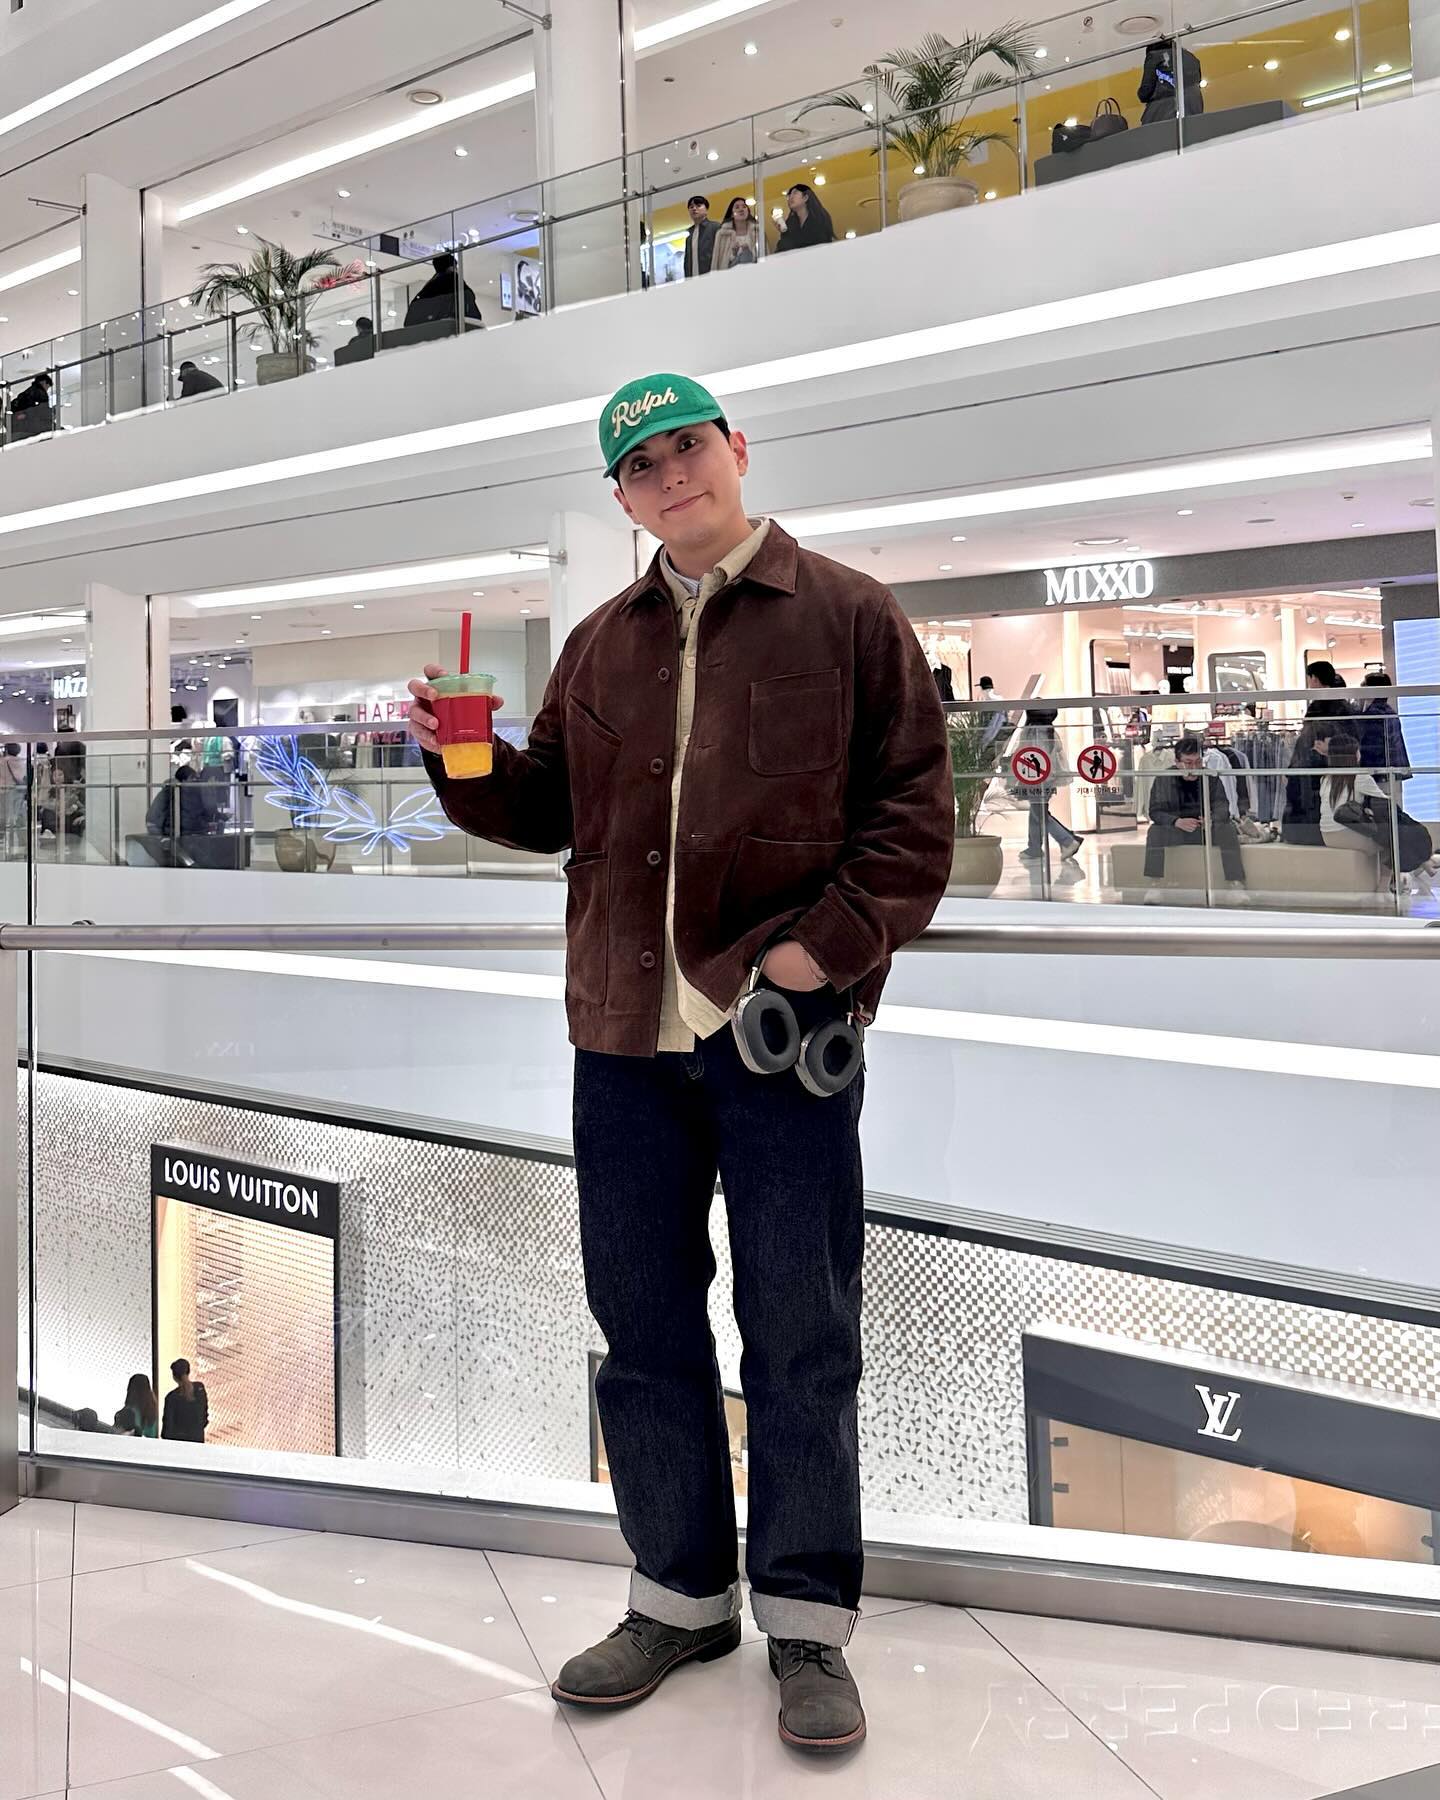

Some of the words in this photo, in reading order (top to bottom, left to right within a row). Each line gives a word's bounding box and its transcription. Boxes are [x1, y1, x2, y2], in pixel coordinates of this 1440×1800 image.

[611, 386, 679, 439] Ralph
[1043, 560, 1154, 606] MIXXO
[164, 1157, 221, 1194] LOUIS
[226, 1171, 319, 1219] VUITTON
